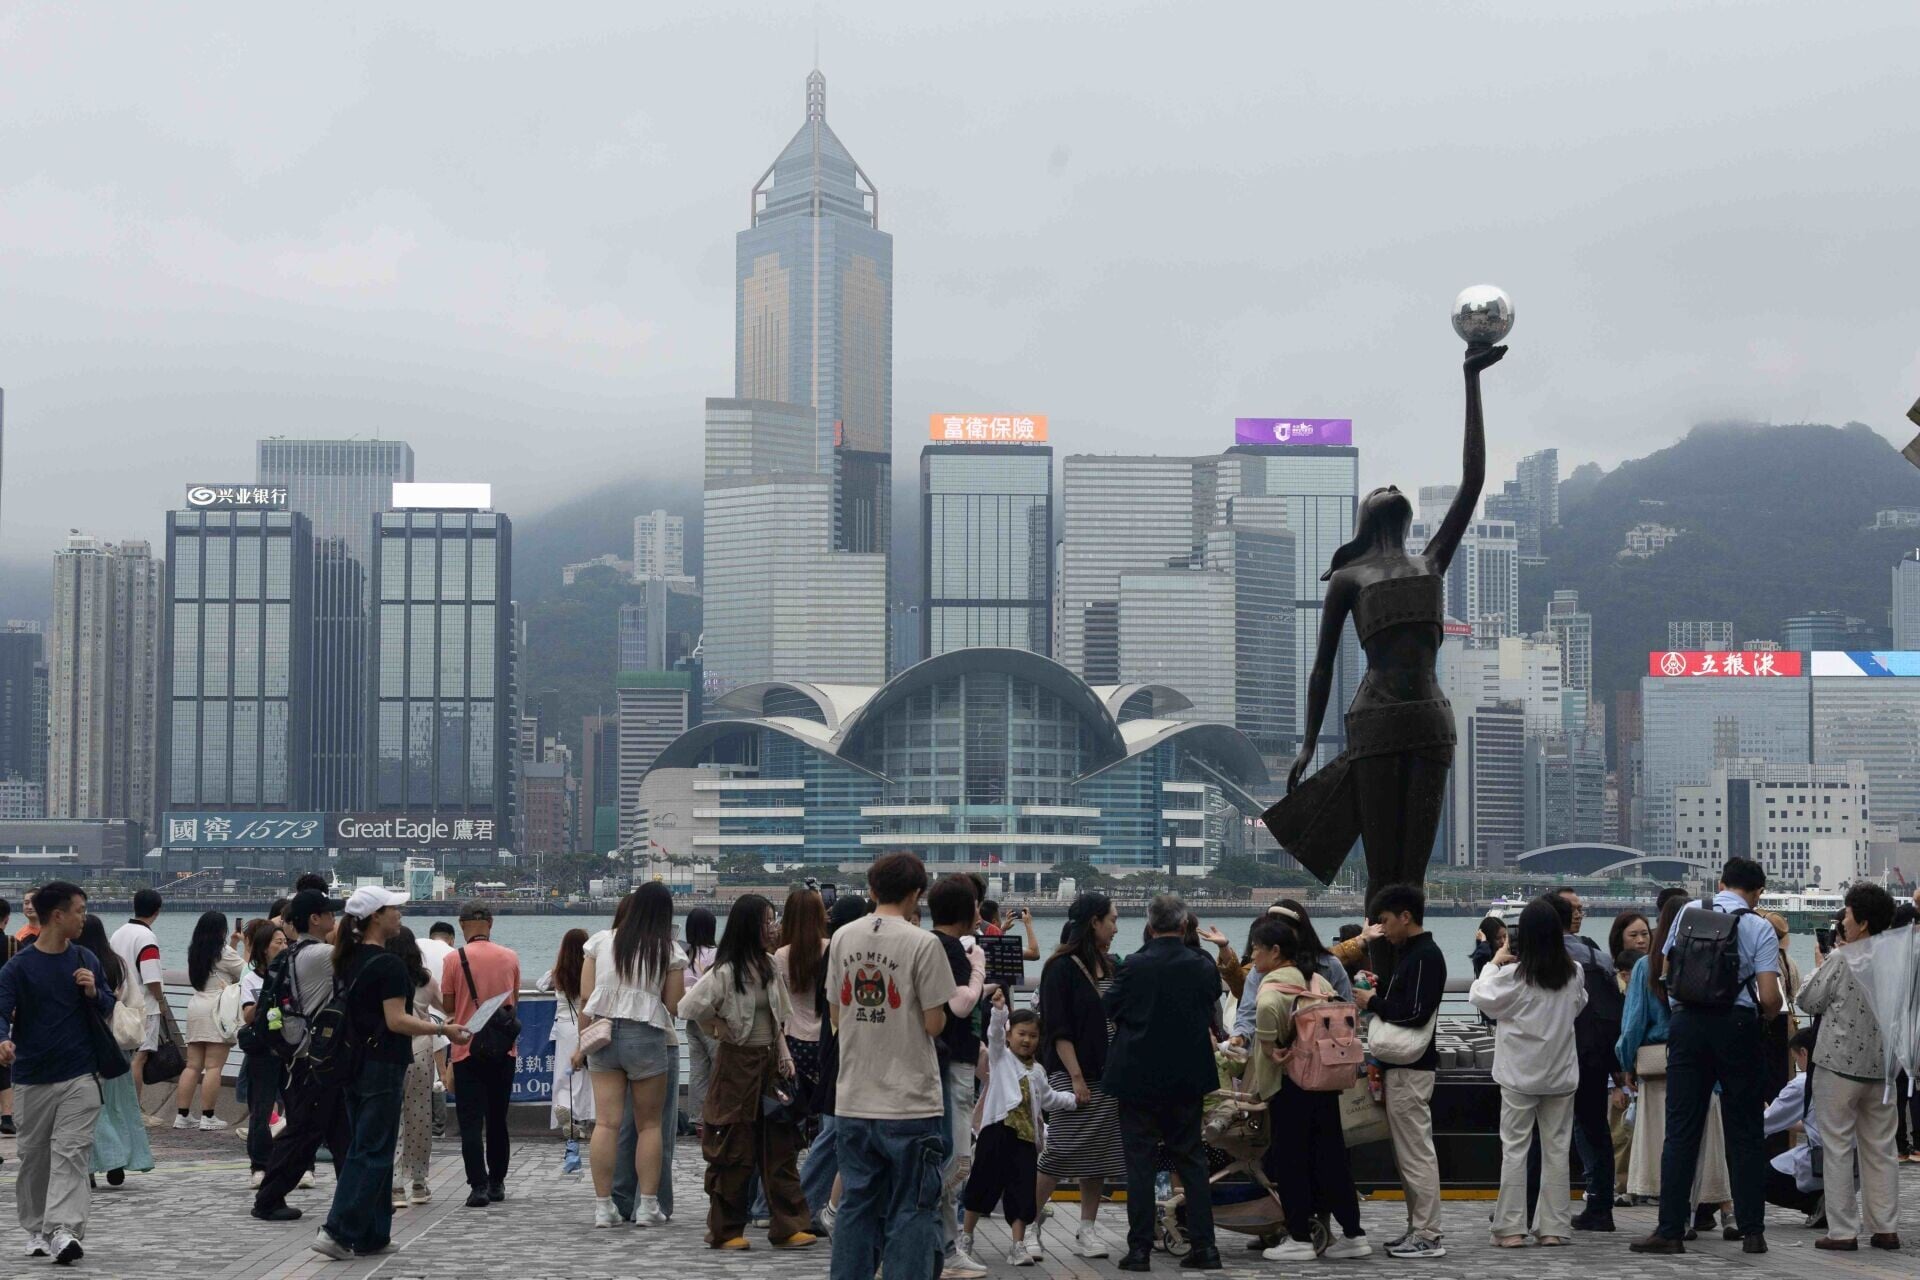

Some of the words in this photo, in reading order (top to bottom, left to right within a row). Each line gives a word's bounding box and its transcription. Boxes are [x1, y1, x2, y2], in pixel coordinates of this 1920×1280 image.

[943, 416, 1035, 439] 富衛保險
[217, 487, 287, 504] 兴业银行
[1692, 653, 1783, 676] 五粮液
[169, 817, 232, 843] 國窖
[235, 819, 319, 840] 1573
[338, 817, 392, 838] Great
[395, 818, 449, 844] Eagle
[452, 819, 495, 841] 鷹君
[867, 951, 899, 971] MEAW
